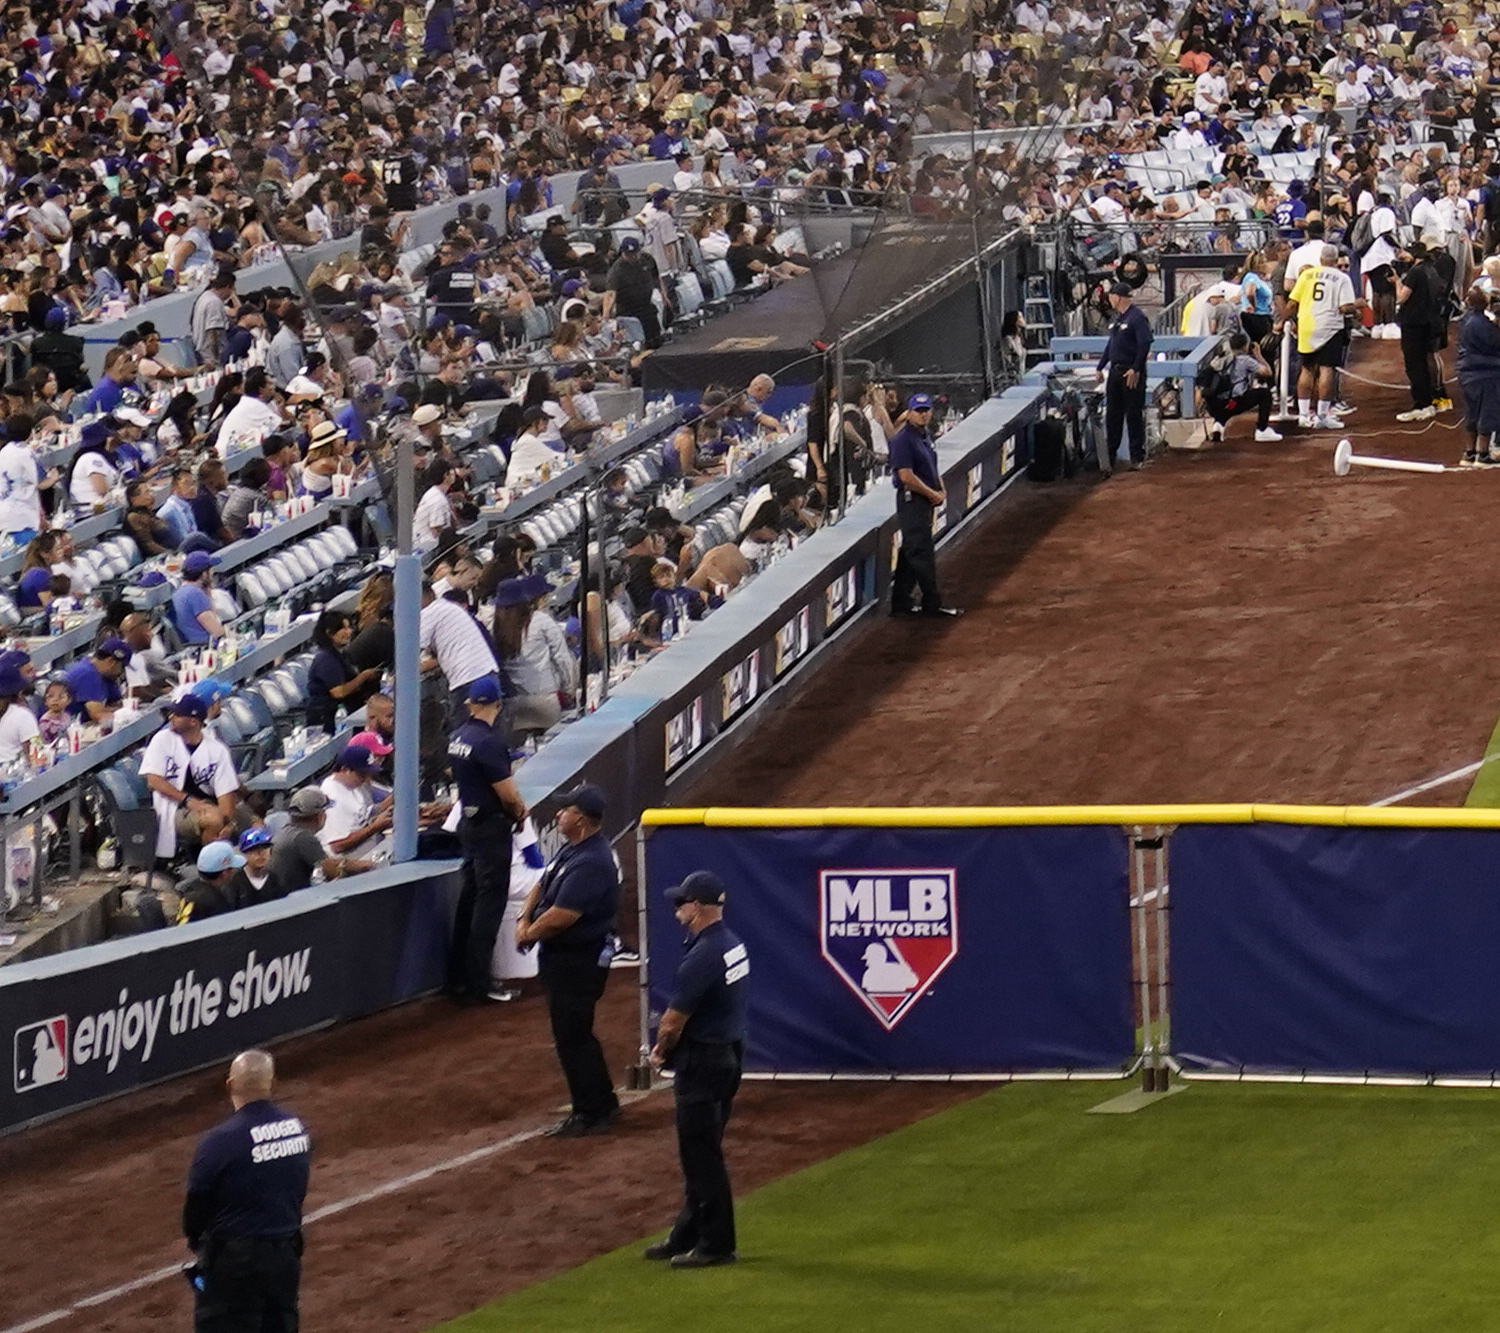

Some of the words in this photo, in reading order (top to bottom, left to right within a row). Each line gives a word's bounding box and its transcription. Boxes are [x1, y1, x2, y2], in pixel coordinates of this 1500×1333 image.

[1312, 281, 1326, 302] 6
[829, 879, 950, 921] MLB
[829, 921, 950, 937] NETWORK
[73, 987, 166, 1074] enjoy
[169, 969, 222, 1035] the
[226, 947, 312, 1019] show.
